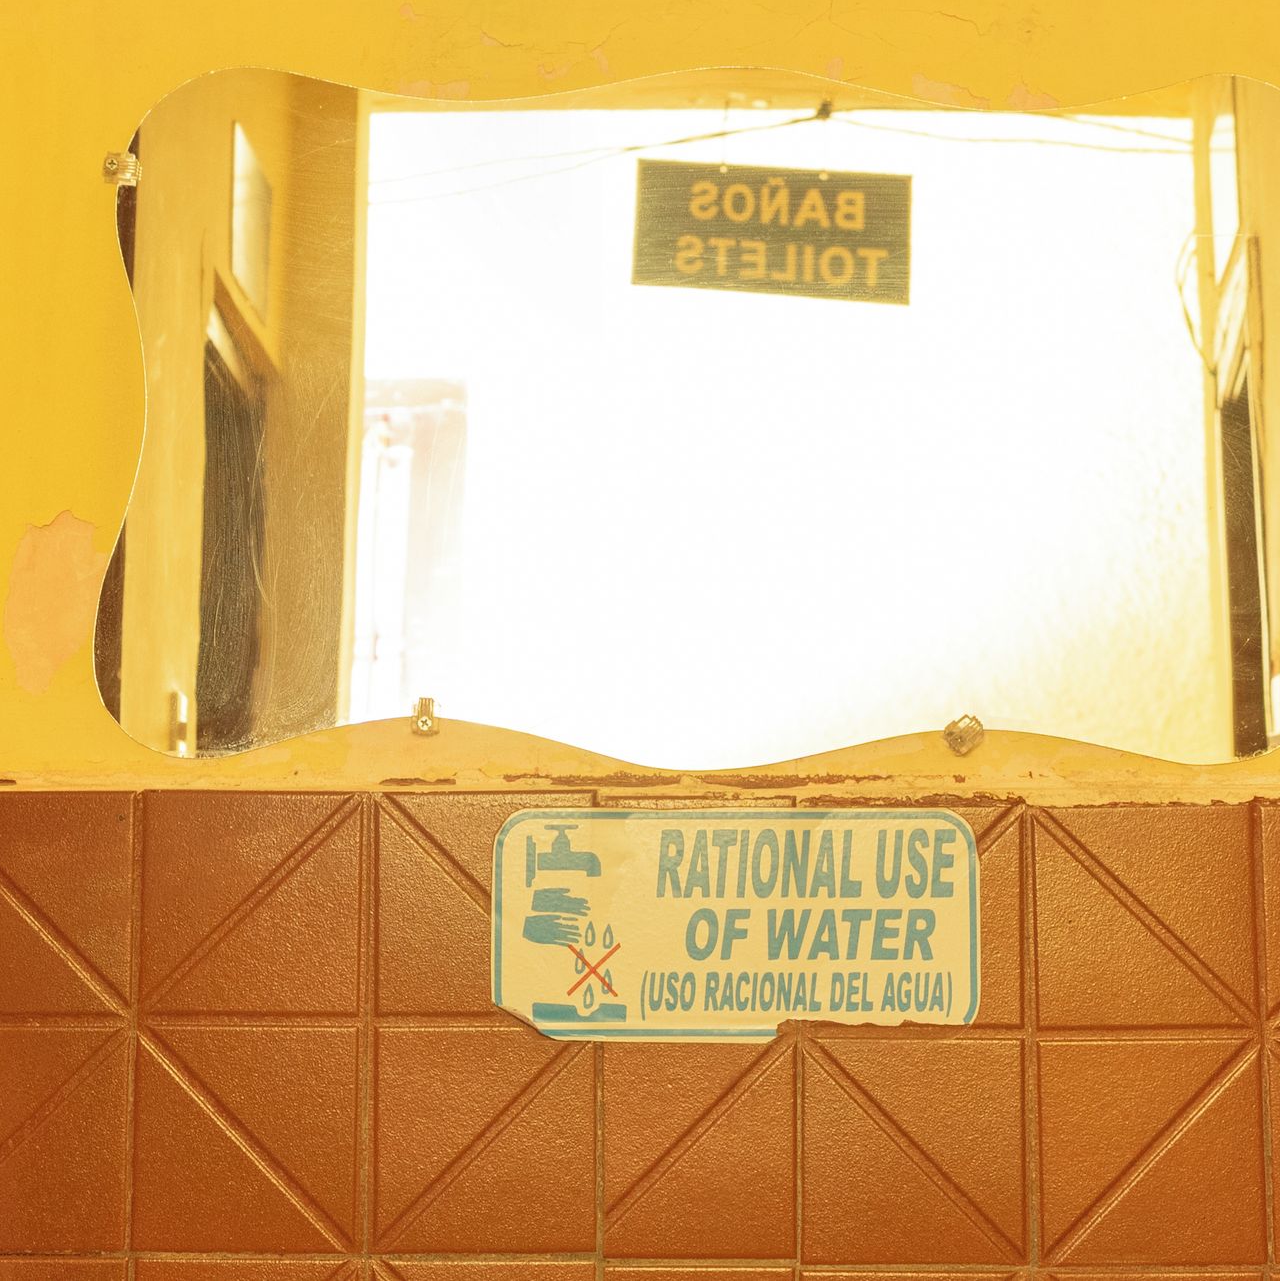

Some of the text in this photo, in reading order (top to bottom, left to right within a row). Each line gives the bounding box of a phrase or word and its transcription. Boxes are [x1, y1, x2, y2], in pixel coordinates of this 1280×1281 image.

[656, 828, 956, 899] RATIONAL USE
[685, 908, 936, 960] OF WATER
[641, 970, 953, 1020] (USO RACIONAL DEL AGUA)
